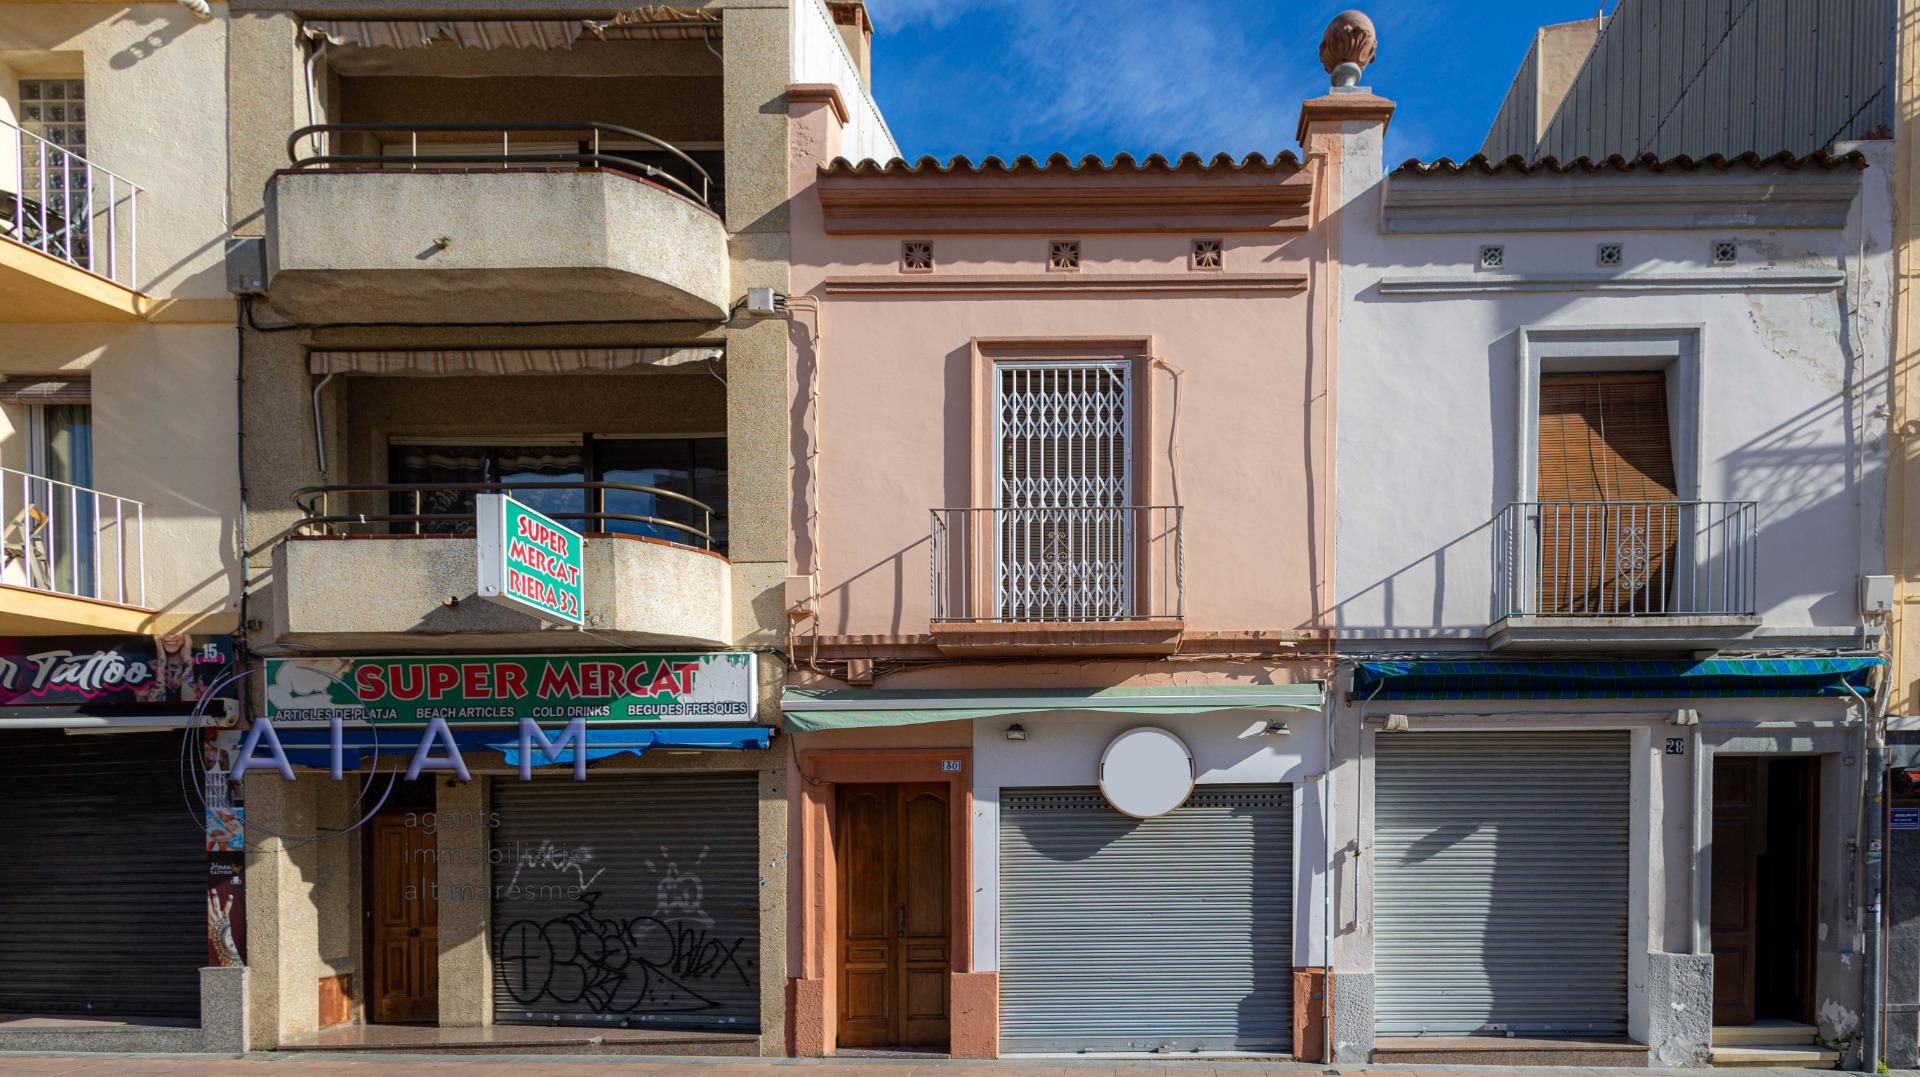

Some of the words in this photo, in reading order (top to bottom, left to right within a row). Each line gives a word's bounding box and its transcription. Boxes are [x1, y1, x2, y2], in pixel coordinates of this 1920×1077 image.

[518, 515, 567, 558] SUPER
[509, 537, 579, 587] MERCAT
[509, 567, 557, 608] RIERA
[560, 590, 578, 616] 32
[202, 643, 217, 659] 15
[28, 650, 152, 691] Tattoo
[355, 663, 528, 700] SUPER
[537, 659, 700, 699] MERCAT
[275, 708, 334, 721] ARTICLES
[335, 708, 350, 720] DE
[354, 708, 398, 719] PLATJA
[416, 707, 457, 718] BEACH
[458, 706, 515, 718] ARTICLES
[532, 706, 566, 717] COLD
[568, 705, 610, 717] DRINKS
[628, 704, 683, 716] BEGUDES
[685, 702, 748, 715] FRESQUES
[1667, 740, 1683, 753] 28
